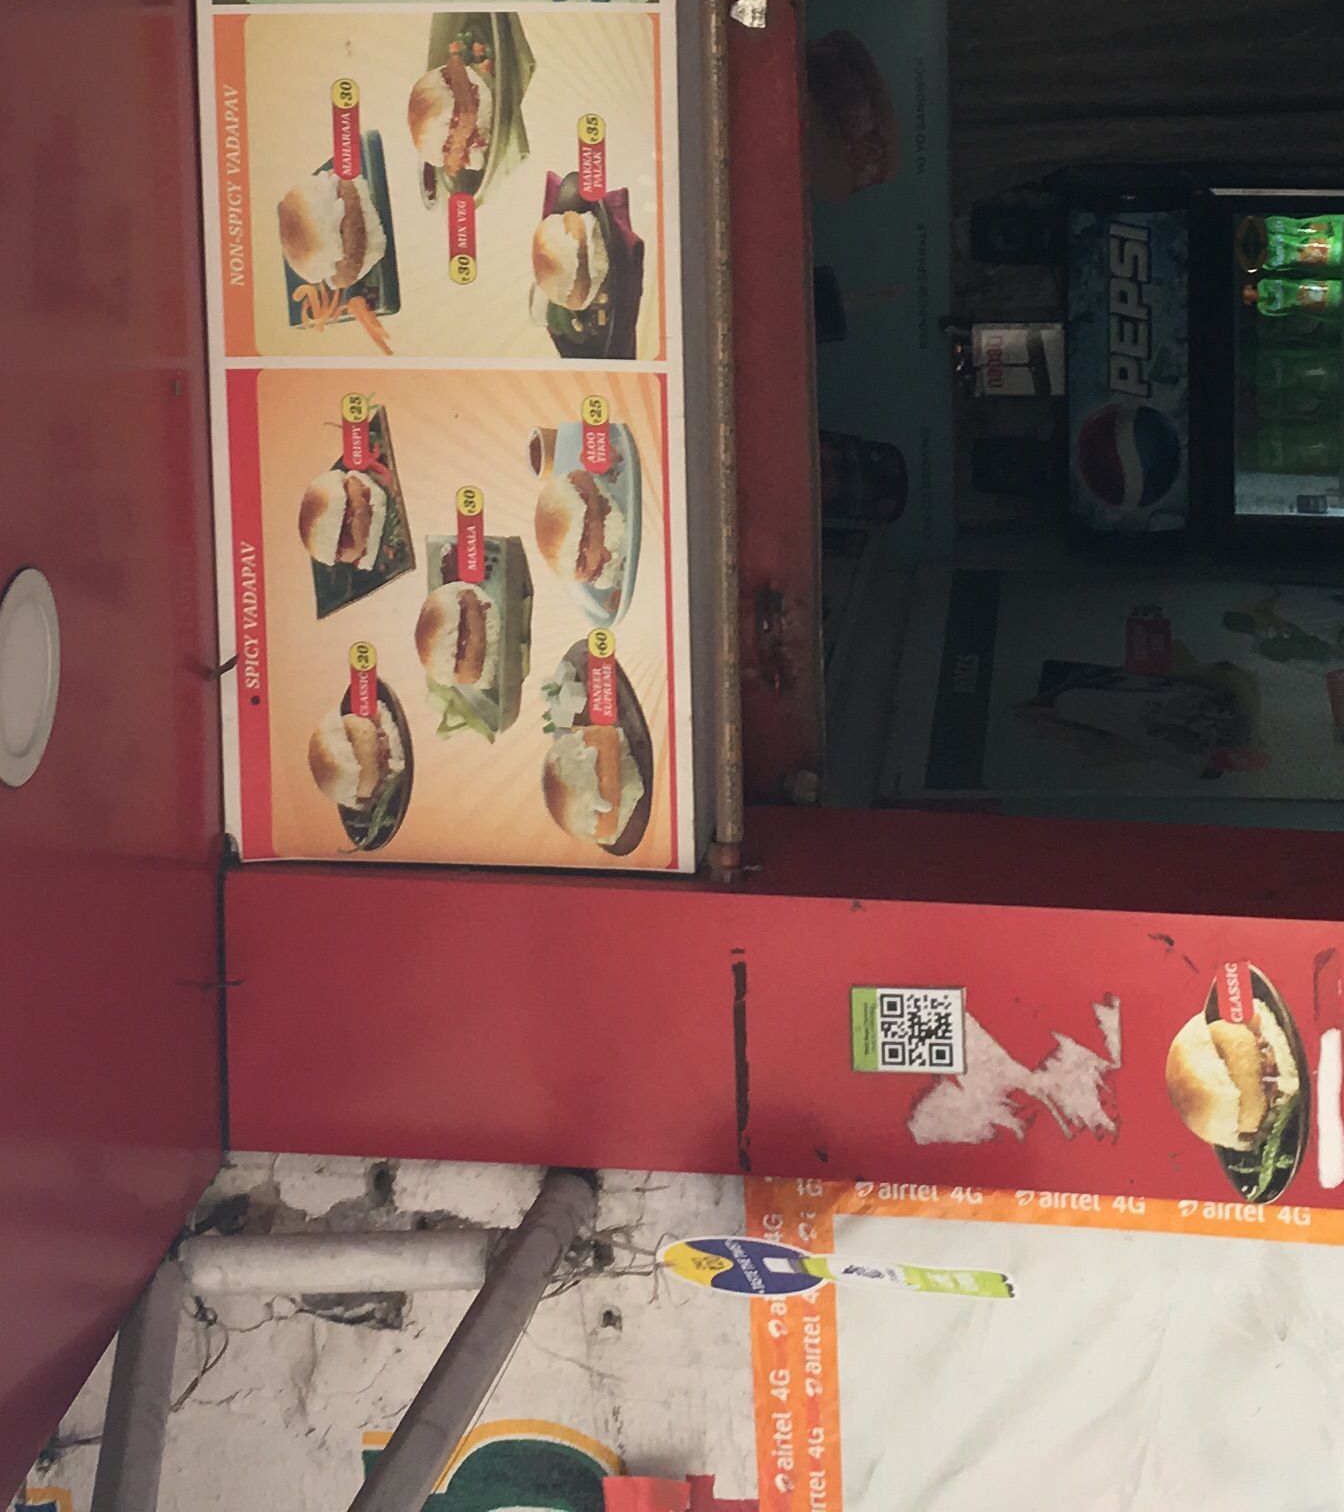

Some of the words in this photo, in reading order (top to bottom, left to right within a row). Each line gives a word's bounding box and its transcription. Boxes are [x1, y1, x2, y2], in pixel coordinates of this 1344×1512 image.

[223, 84, 242, 175] VADAPAV
[339, 112, 353, 176] MAHARAJA
[581, 145, 594, 192] MAKKAI
[592, 151, 604, 188] PALAK
[456, 199, 468, 223] VEG
[227, 183, 245, 286] NON-SPICY
[457, 226, 468, 249] MIX
[1107, 221, 1152, 399] PEPSI
[352, 425, 363, 465] CRISPY
[586, 432, 598, 463] ALOO
[596, 432, 607, 462] TIKKI
[465, 525, 478, 571] MASALA
[240, 540, 259, 629] VADAPAV
[243, 634, 261, 689] SPICY
[358, 672, 370, 716] CLASSIC
[592, 667, 603, 711] PANEER
[601, 663, 613, 716] SUPREME
[1224, 962, 1244, 1023] CLASSIC
[878, 1181, 939, 1201] airtel
[948, 1185, 984, 1205] 4G
[1039, 1189, 1102, 1212] airtel
[1112, 1195, 1146, 1215] 4G
[1202, 1201, 1266, 1223] airtel
[1278, 1205, 1312, 1226] 4G
[761, 1214, 784, 1243] 4G
[803, 1315, 824, 1375] airtel
[769, 1368, 791, 1402] 4G
[771, 1411, 794, 1471] airtel
[807, 1427, 826, 1459] 4G
